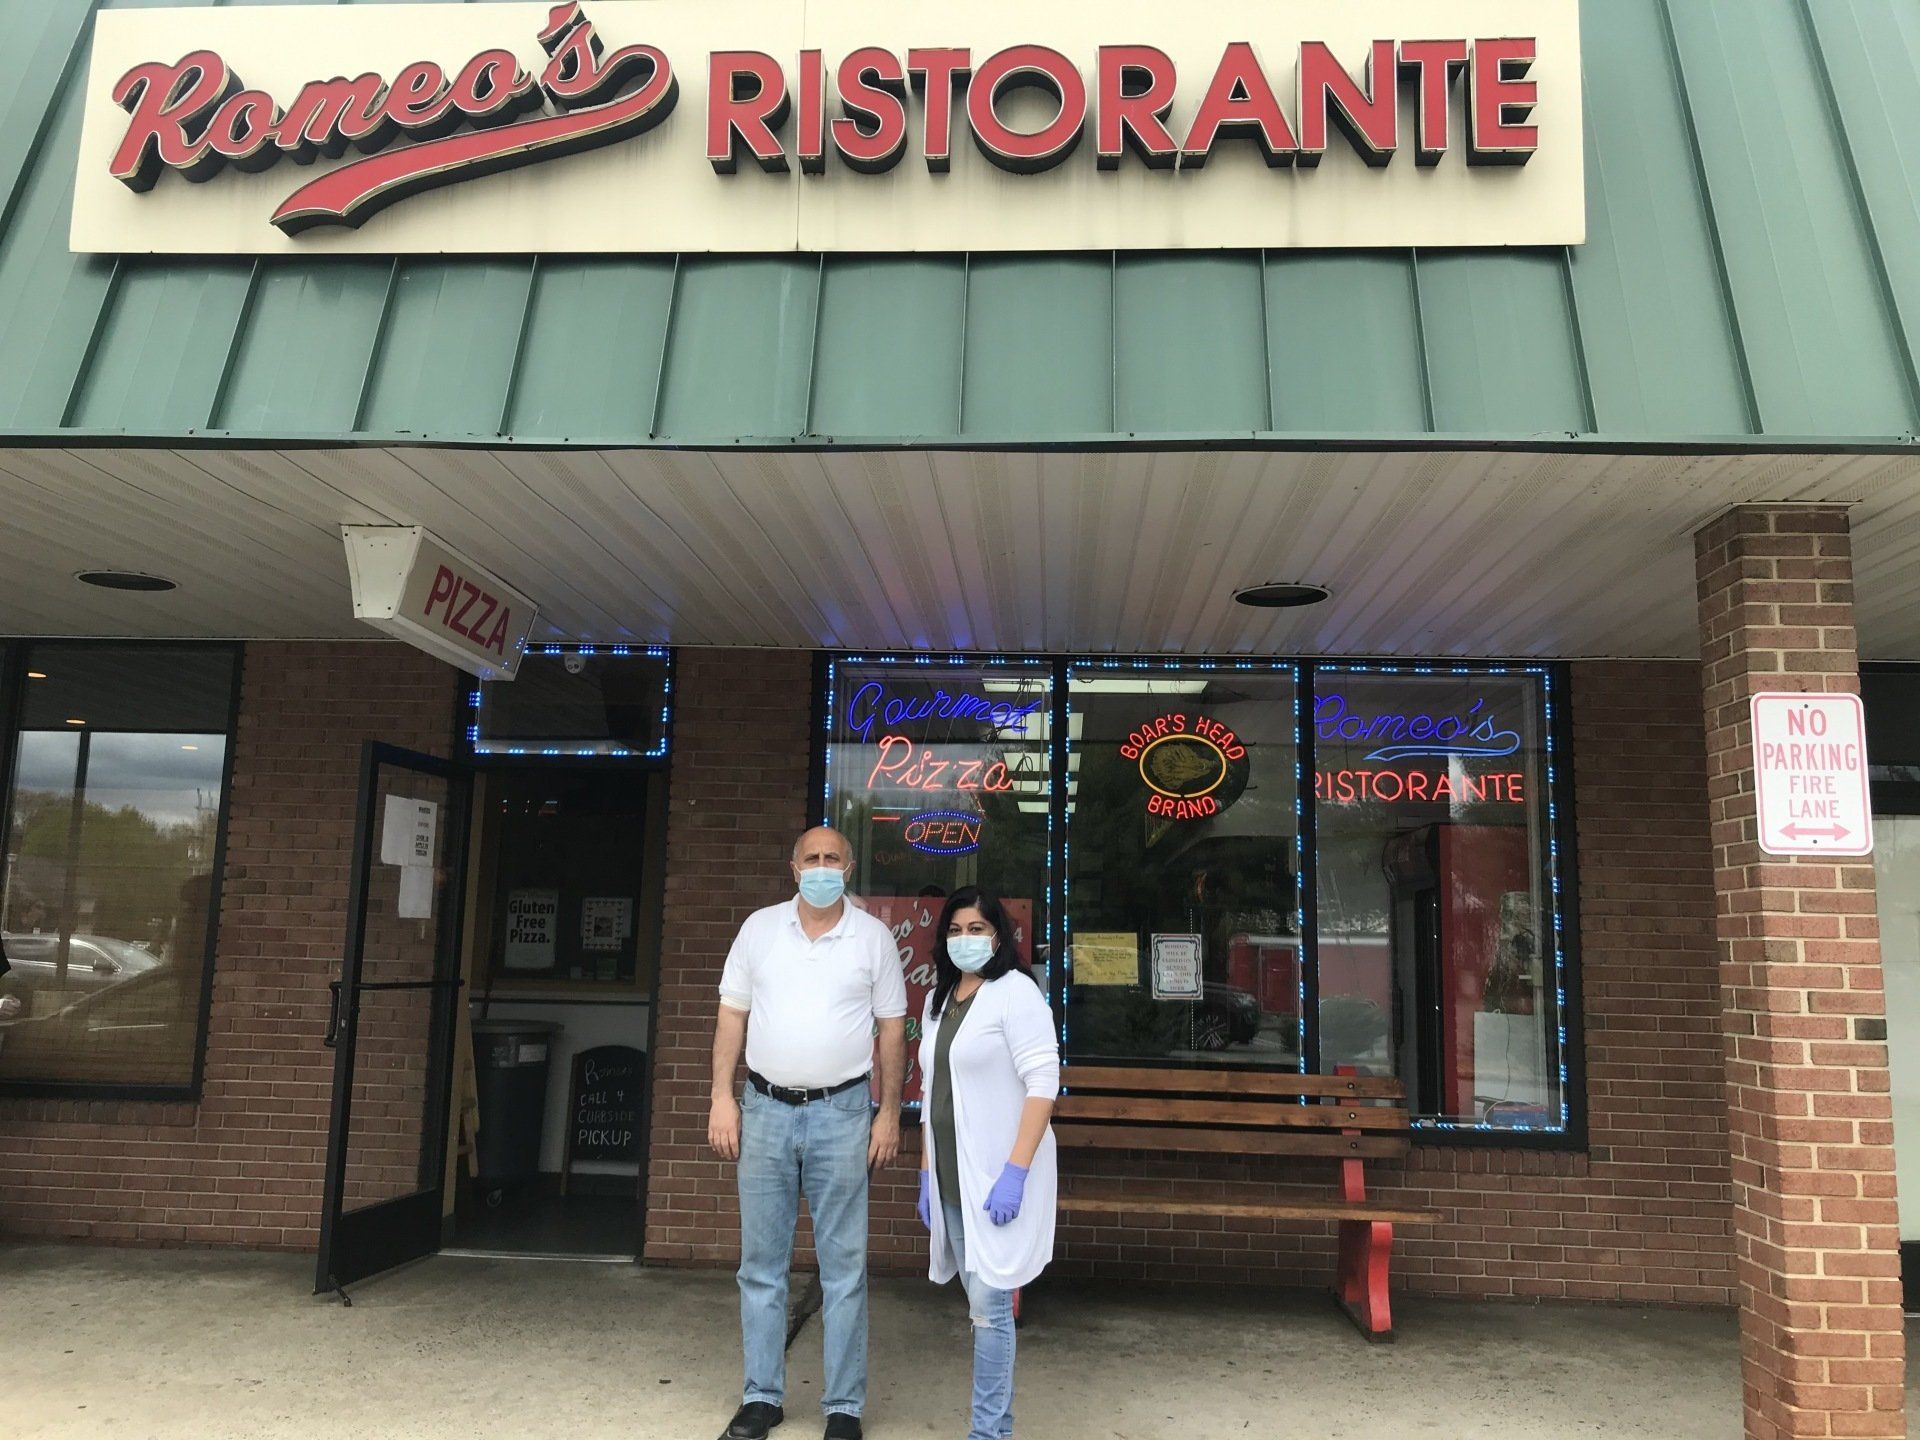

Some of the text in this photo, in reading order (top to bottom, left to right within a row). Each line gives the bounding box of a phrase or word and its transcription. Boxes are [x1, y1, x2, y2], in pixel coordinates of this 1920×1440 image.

[109, 0, 1539, 192] Romeo's RISTORANTE
[424, 564, 511, 656] PIZZA
[848, 681, 1042, 743] Gourmet
[1787, 708, 1827, 737] NO
[1120, 713, 1245, 760] BOAR'S HEAD
[867, 735, 1014, 791] Pizza
[1762, 742, 1858, 771] PARKING
[1788, 775, 1837, 795] FIRE
[1147, 794, 1217, 820] BRAND
[1788, 799, 1841, 819] LANE
[904, 821, 982, 844] OPEN
[508, 899, 555, 914] Gluten
[516, 914, 546, 929] Free
[509, 928, 551, 944] Pizza.
[580, 1090, 624, 1106] CALL 4
[578, 1129, 632, 1147] PICKUP
